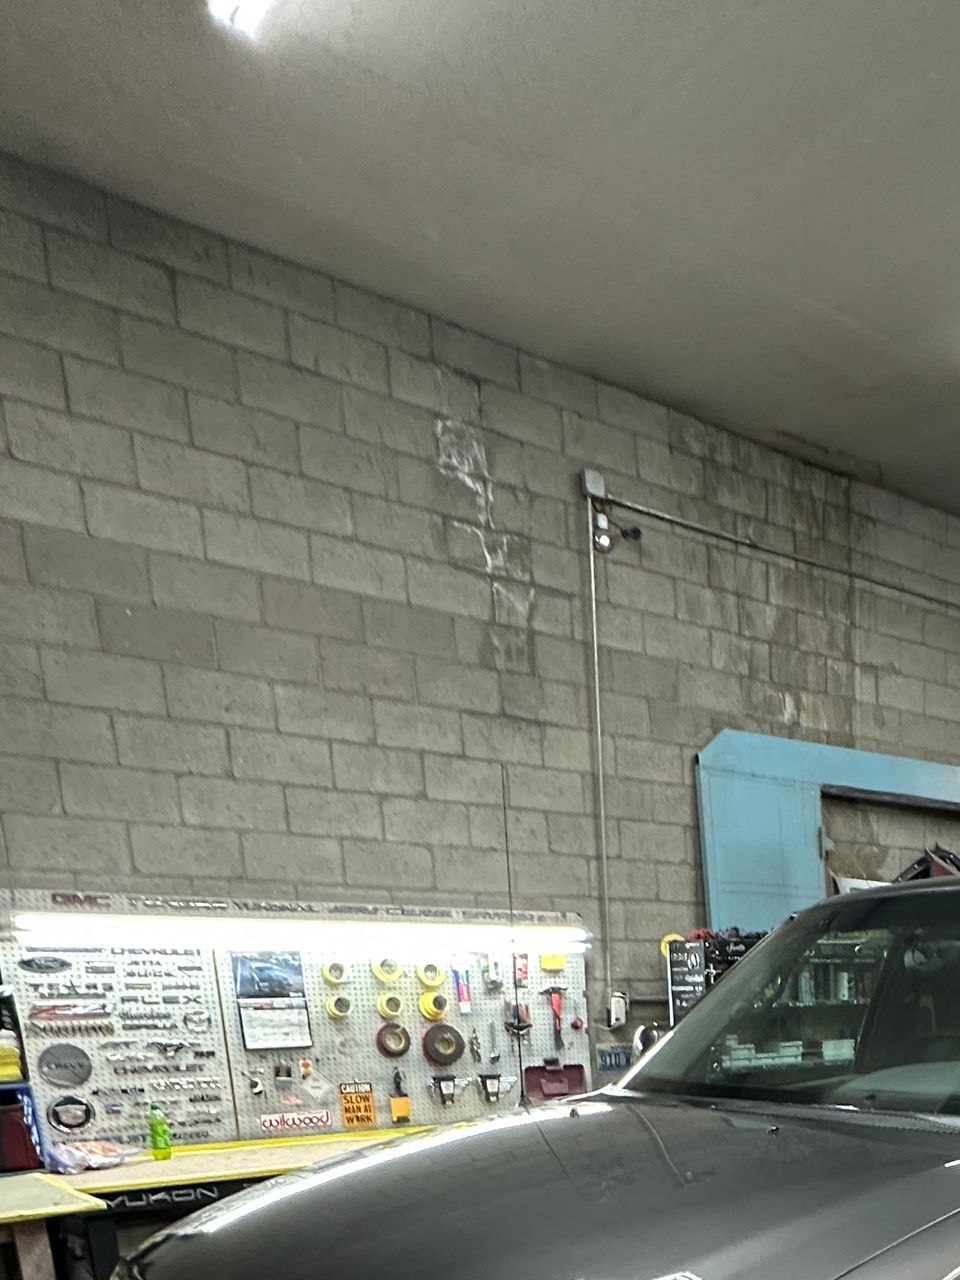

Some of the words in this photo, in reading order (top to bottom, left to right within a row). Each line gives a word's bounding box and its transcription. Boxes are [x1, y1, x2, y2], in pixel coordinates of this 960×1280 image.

[120, 995, 202, 1005] FLEX
[340, 1082, 371, 1094] CAUTION
[343, 1094, 371, 1104] SLOW
[344, 1105, 362, 1114] MAN
[345, 1114, 373, 1125] WORK
[106, 1186, 219, 1208] YUKON
